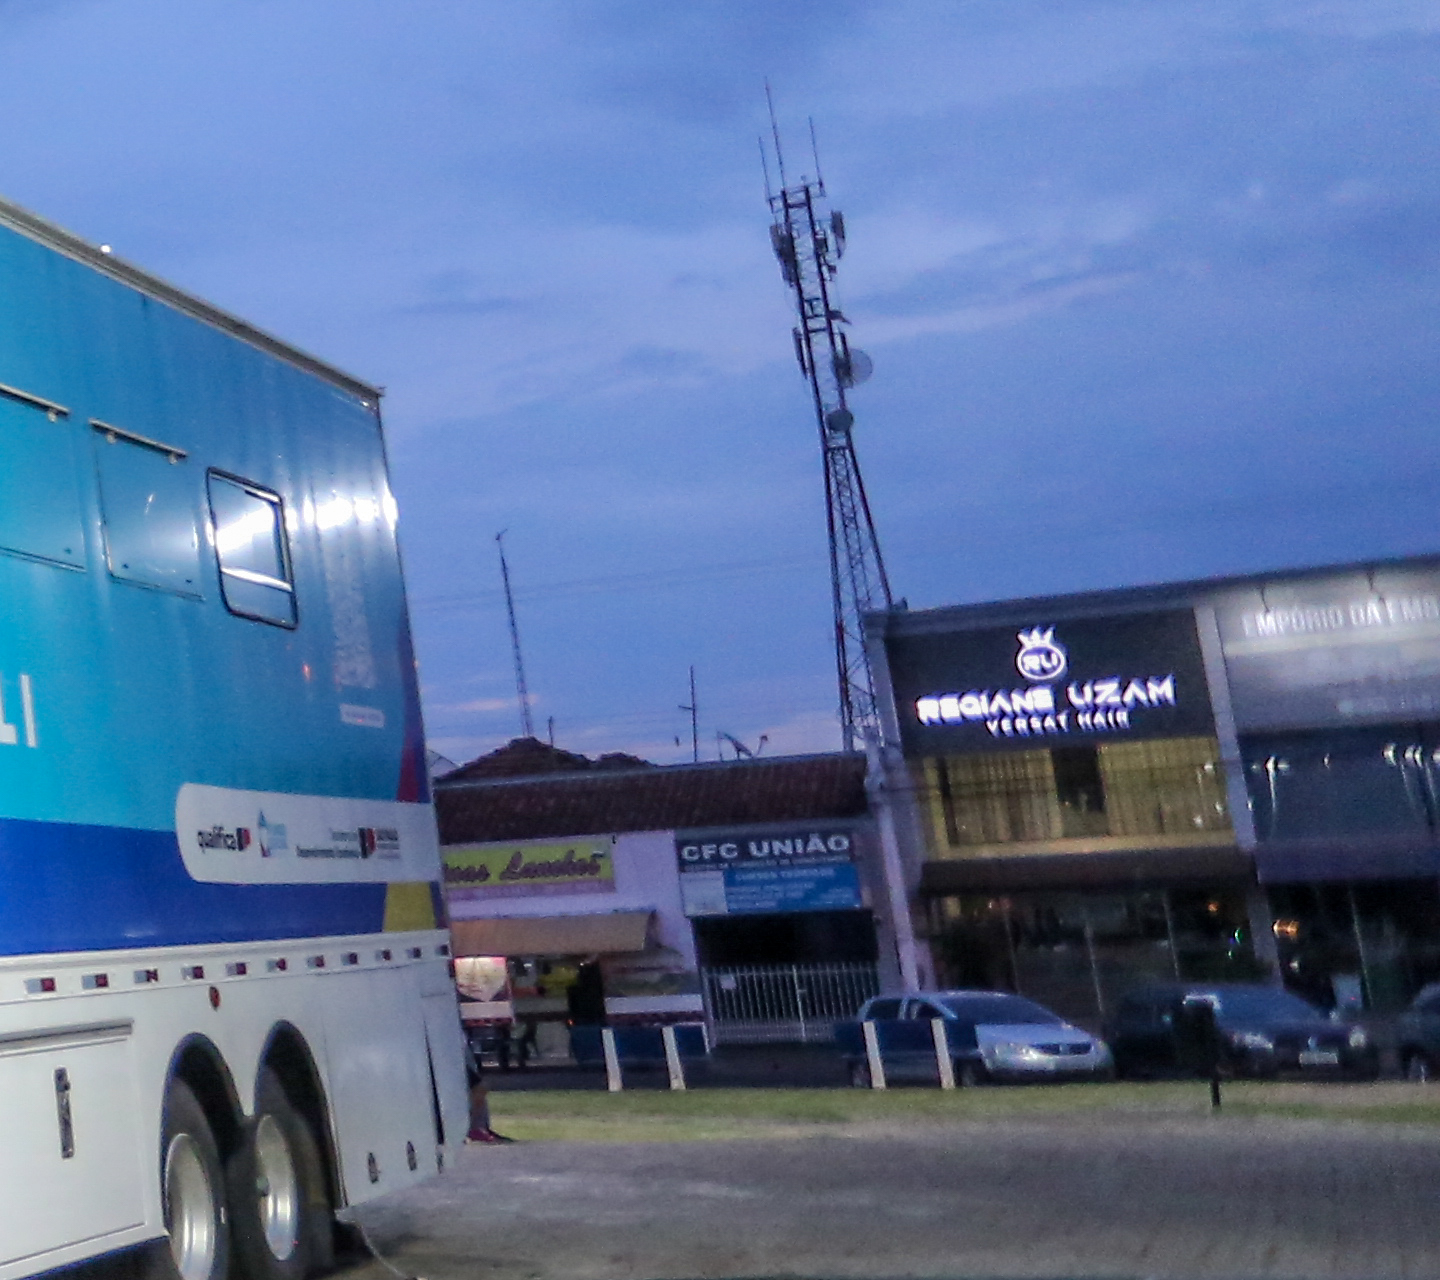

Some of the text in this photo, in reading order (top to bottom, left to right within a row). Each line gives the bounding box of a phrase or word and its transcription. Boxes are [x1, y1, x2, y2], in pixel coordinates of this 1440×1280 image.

[1067, 674, 1177, 708] UZAM
[20, 674, 38, 749] I
[681, 833, 850, 861] CFC UNIÃO
